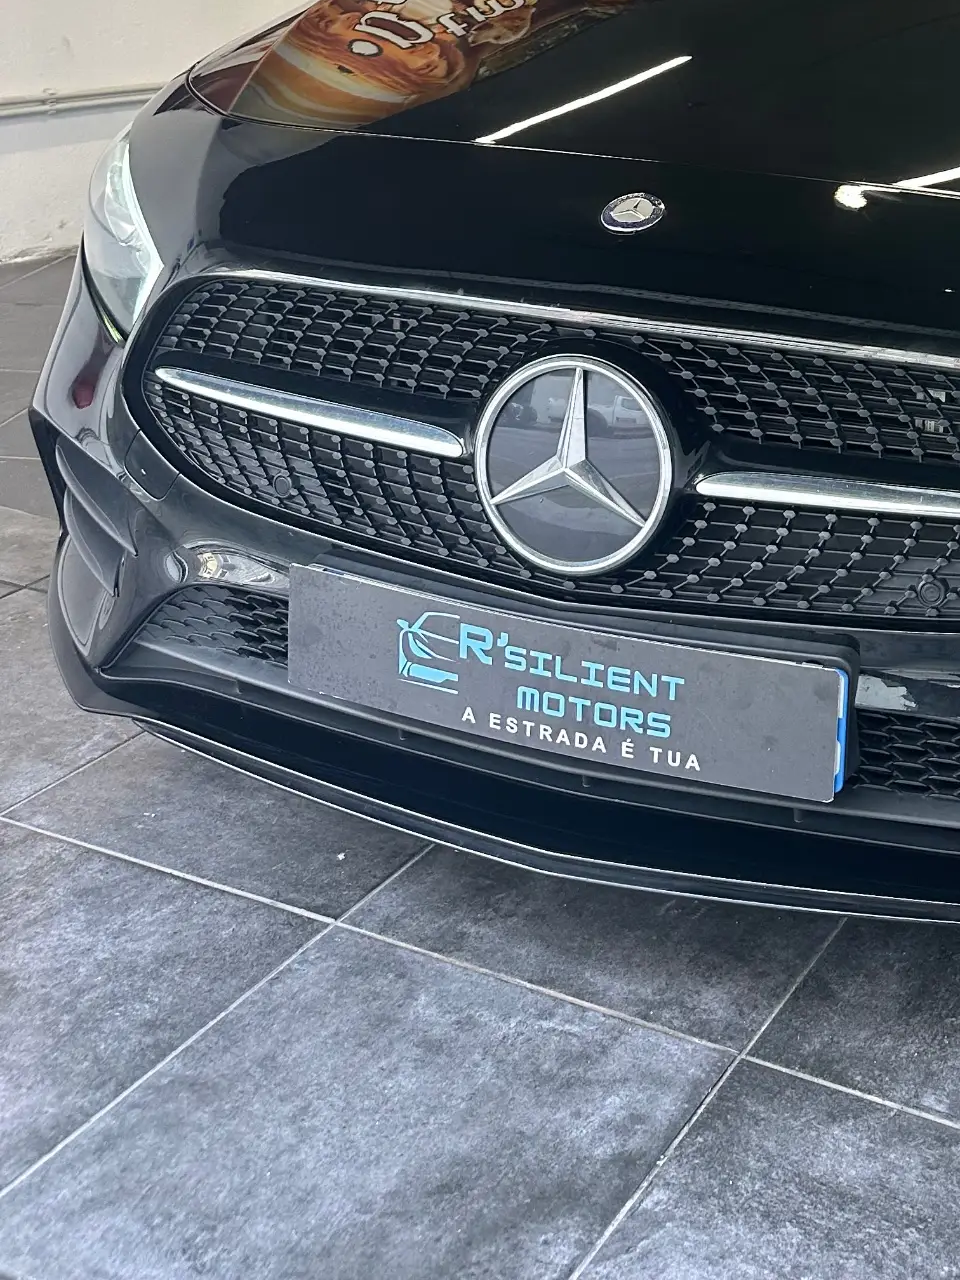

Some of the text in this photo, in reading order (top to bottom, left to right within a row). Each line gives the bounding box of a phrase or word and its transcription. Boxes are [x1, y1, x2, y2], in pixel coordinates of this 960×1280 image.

[458, 623, 686, 701] R'SILIENT
[461, 706, 701, 771] A ESTRADA É TUA
[517, 685, 672, 738] MOTORS
